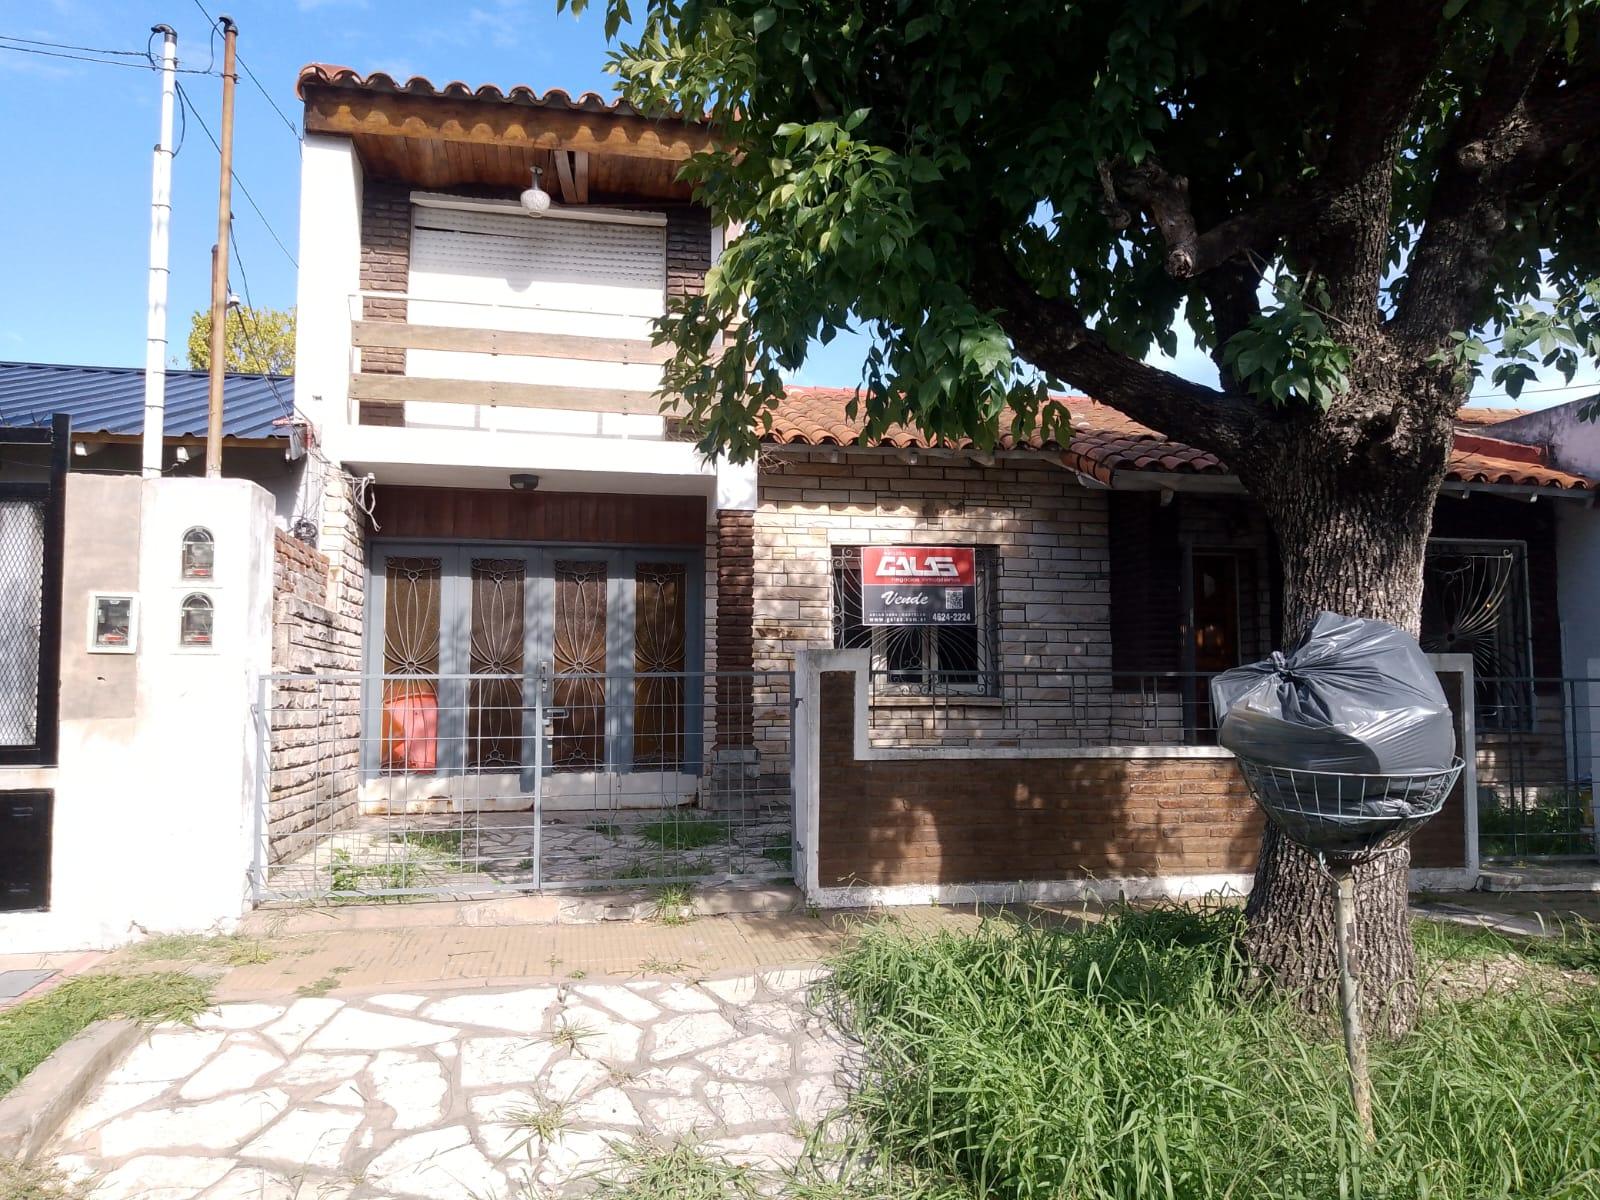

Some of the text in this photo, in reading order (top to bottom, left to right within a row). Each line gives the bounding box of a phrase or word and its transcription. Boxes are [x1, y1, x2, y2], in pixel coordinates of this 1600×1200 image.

[876, 556, 959, 577] GALAS
[881, 590, 929, 606] Vende
[932, 612, 971, 622] 4624-2224
